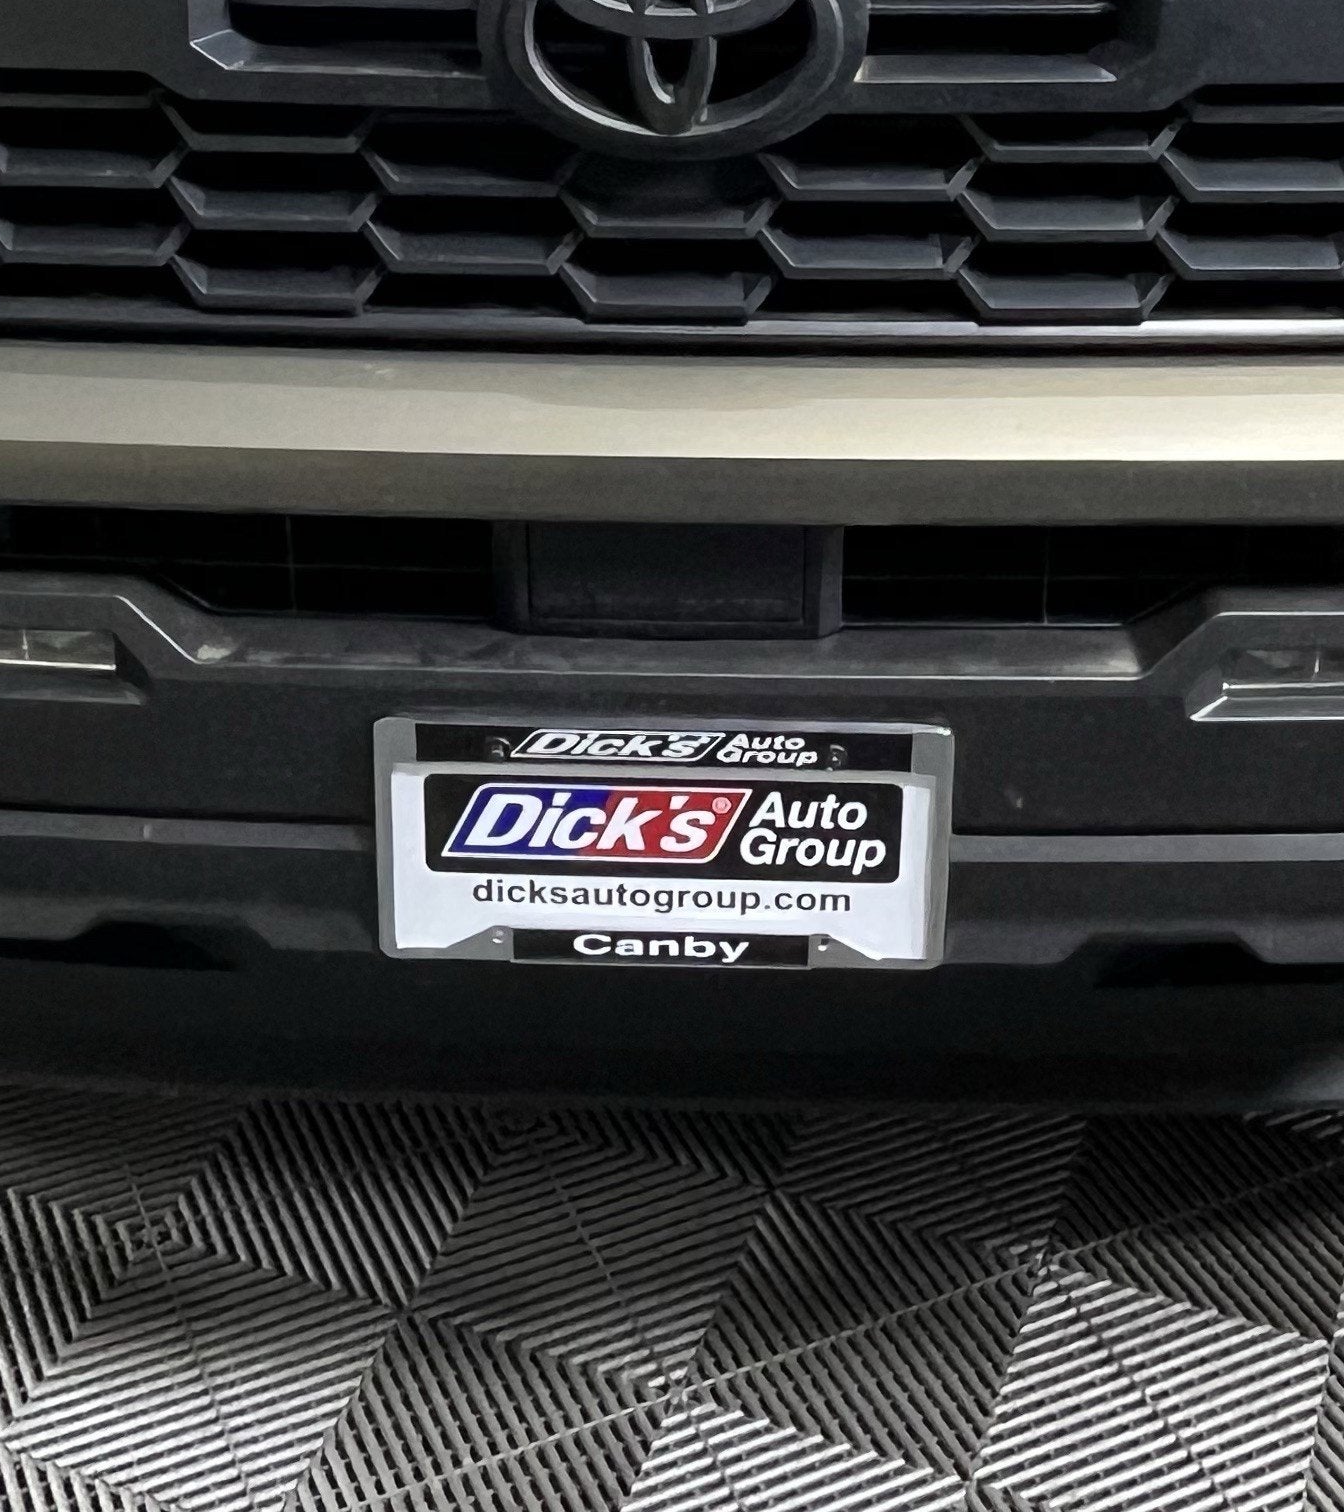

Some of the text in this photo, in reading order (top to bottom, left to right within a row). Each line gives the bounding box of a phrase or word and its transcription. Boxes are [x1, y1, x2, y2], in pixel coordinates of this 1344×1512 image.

[716, 747, 819, 767] Group
[726, 733, 806, 751] Auto
[748, 791, 868, 830] Auto
[739, 828, 887, 876] Group
[471, 879, 851, 914] dicksautogroup.com
[572, 933, 750, 964] Canby
